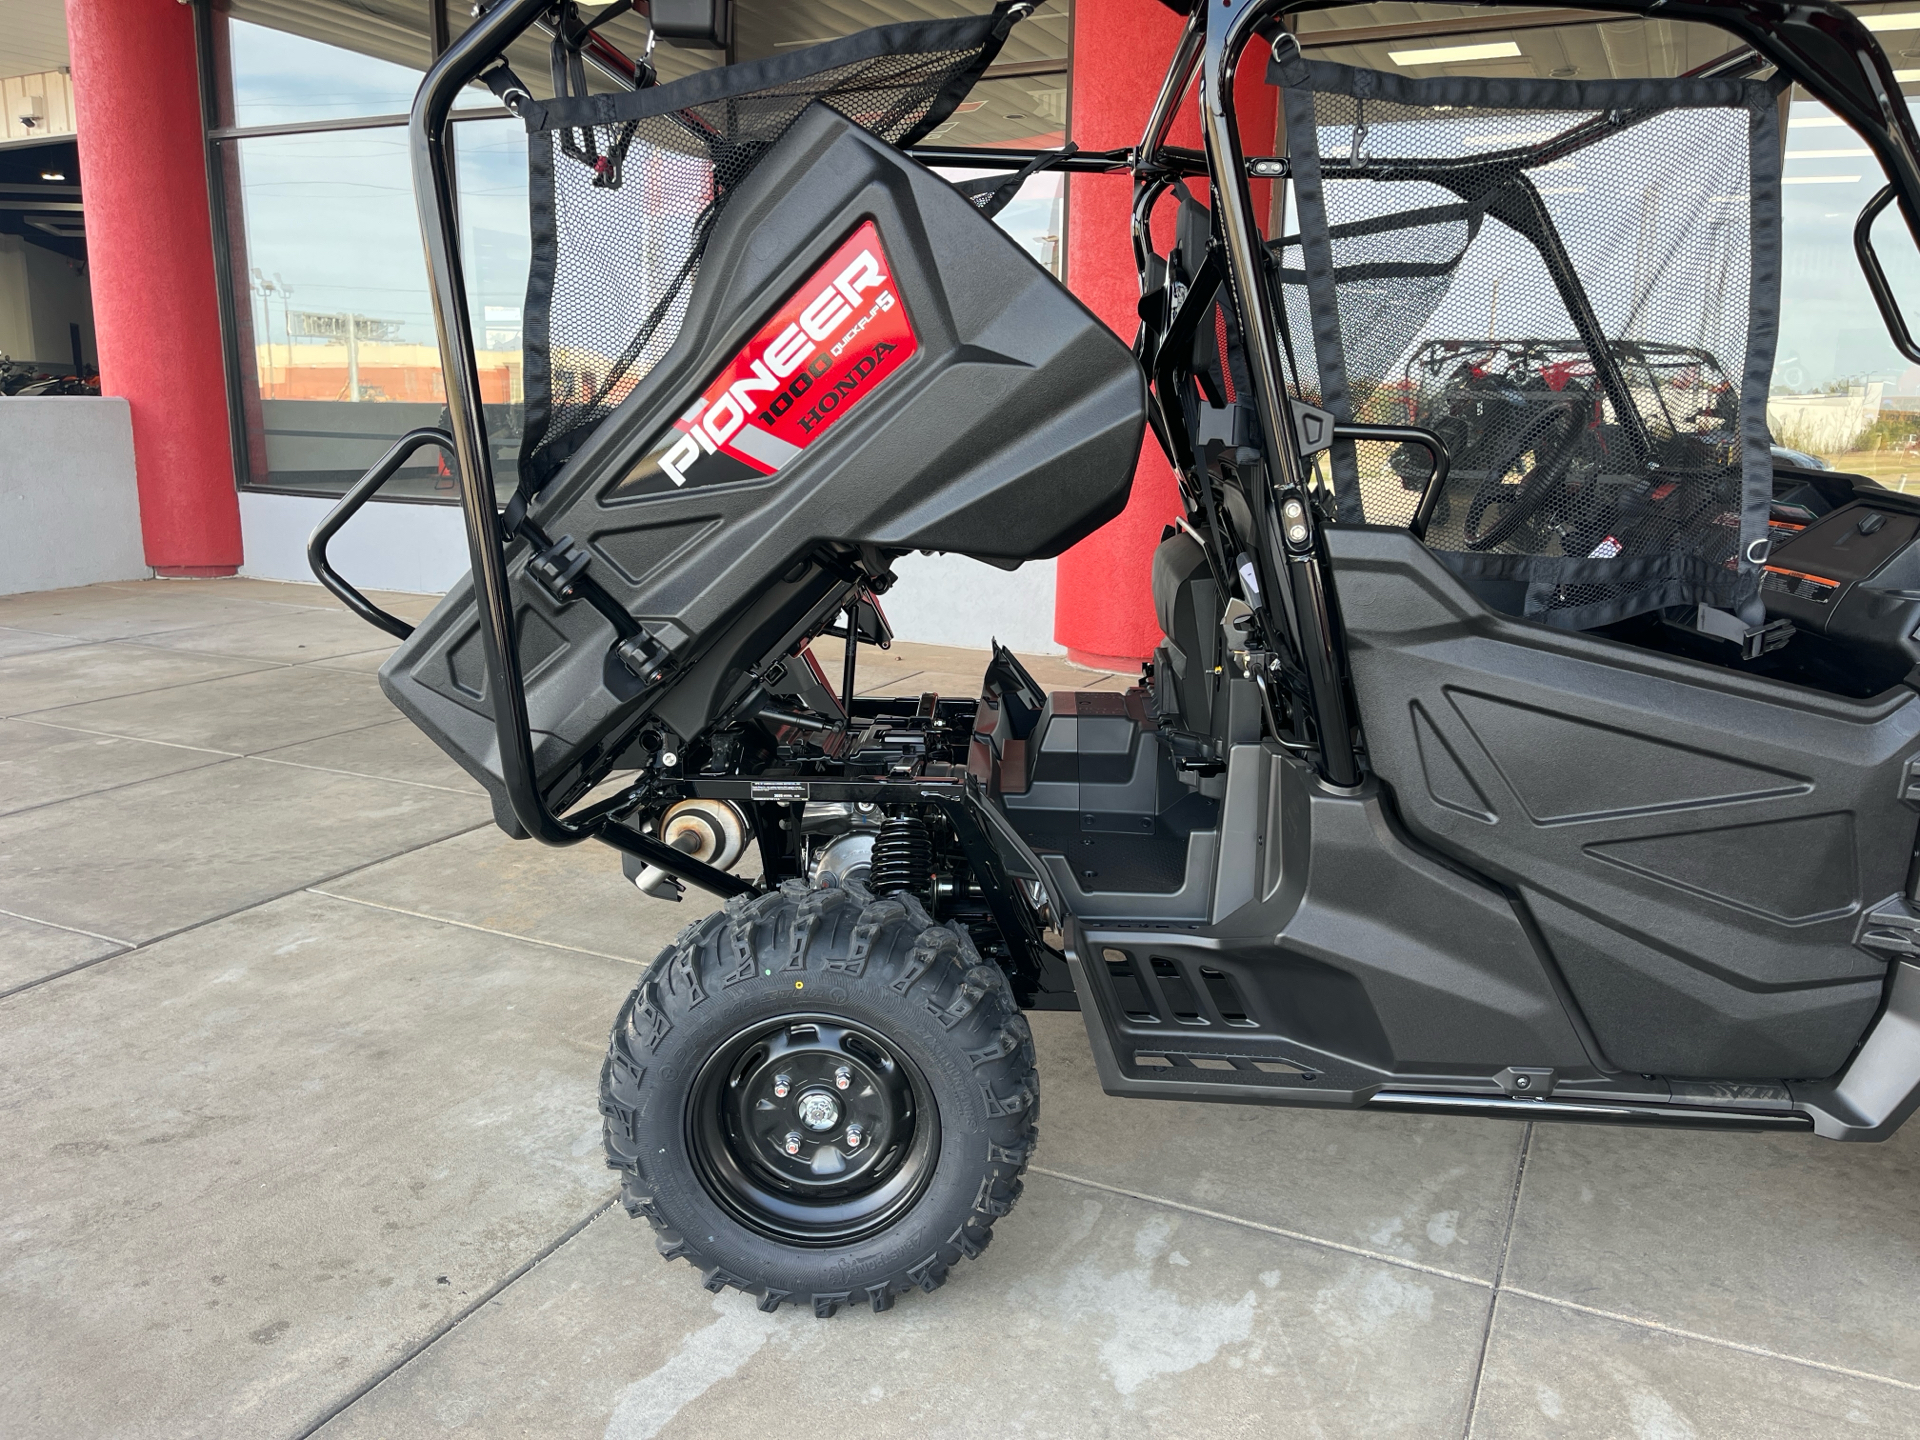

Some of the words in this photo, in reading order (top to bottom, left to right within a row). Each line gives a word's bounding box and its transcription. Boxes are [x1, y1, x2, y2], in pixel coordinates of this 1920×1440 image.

[657, 249, 887, 487] PIONEER
[758, 352, 833, 426] 1000
[797, 341, 898, 434] HONDA
